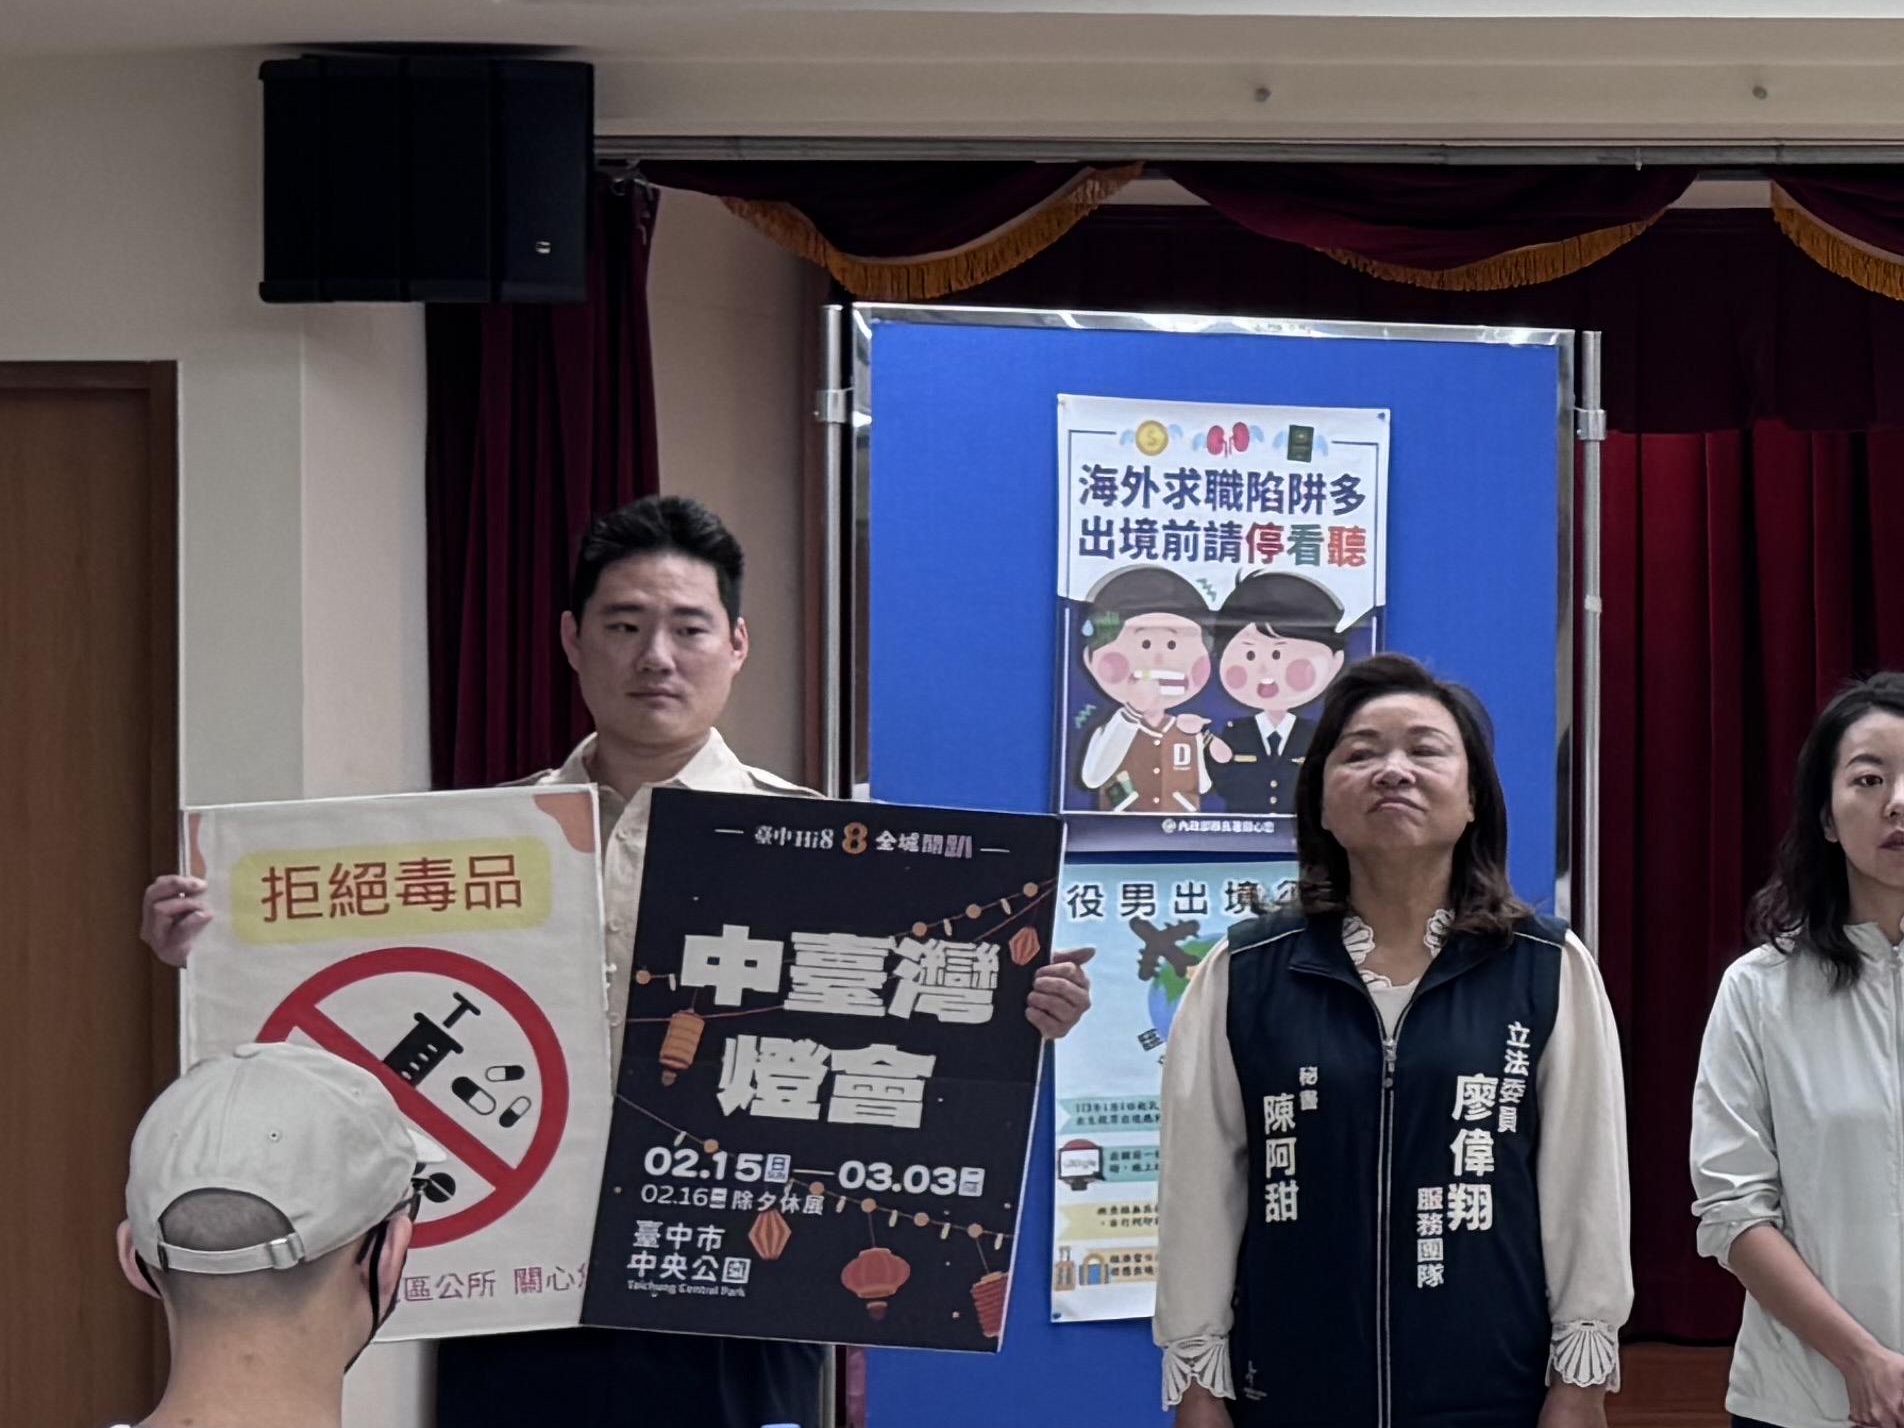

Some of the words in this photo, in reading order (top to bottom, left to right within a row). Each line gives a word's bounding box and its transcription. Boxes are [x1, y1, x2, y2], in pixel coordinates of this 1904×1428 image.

[1078, 464, 1367, 517] 海外求職陷阱多
[1078, 516, 1368, 567] 出境前請停看聽
[261, 853, 524, 924] 拒絕毒品
[680, 924, 1000, 1024] 中臺灣
[716, 1034, 936, 1129] 燈會
[1497, 1021, 1530, 1133] 立法委員
[1263, 1092, 1299, 1223] 陳阿甜
[1447, 1073, 1499, 1232] 廖偉翔
[627, 1250, 751, 1284] 中央公園
[633, 1220, 726, 1252] 臺中市
[1416, 1186, 1444, 1289] 服務團隊
